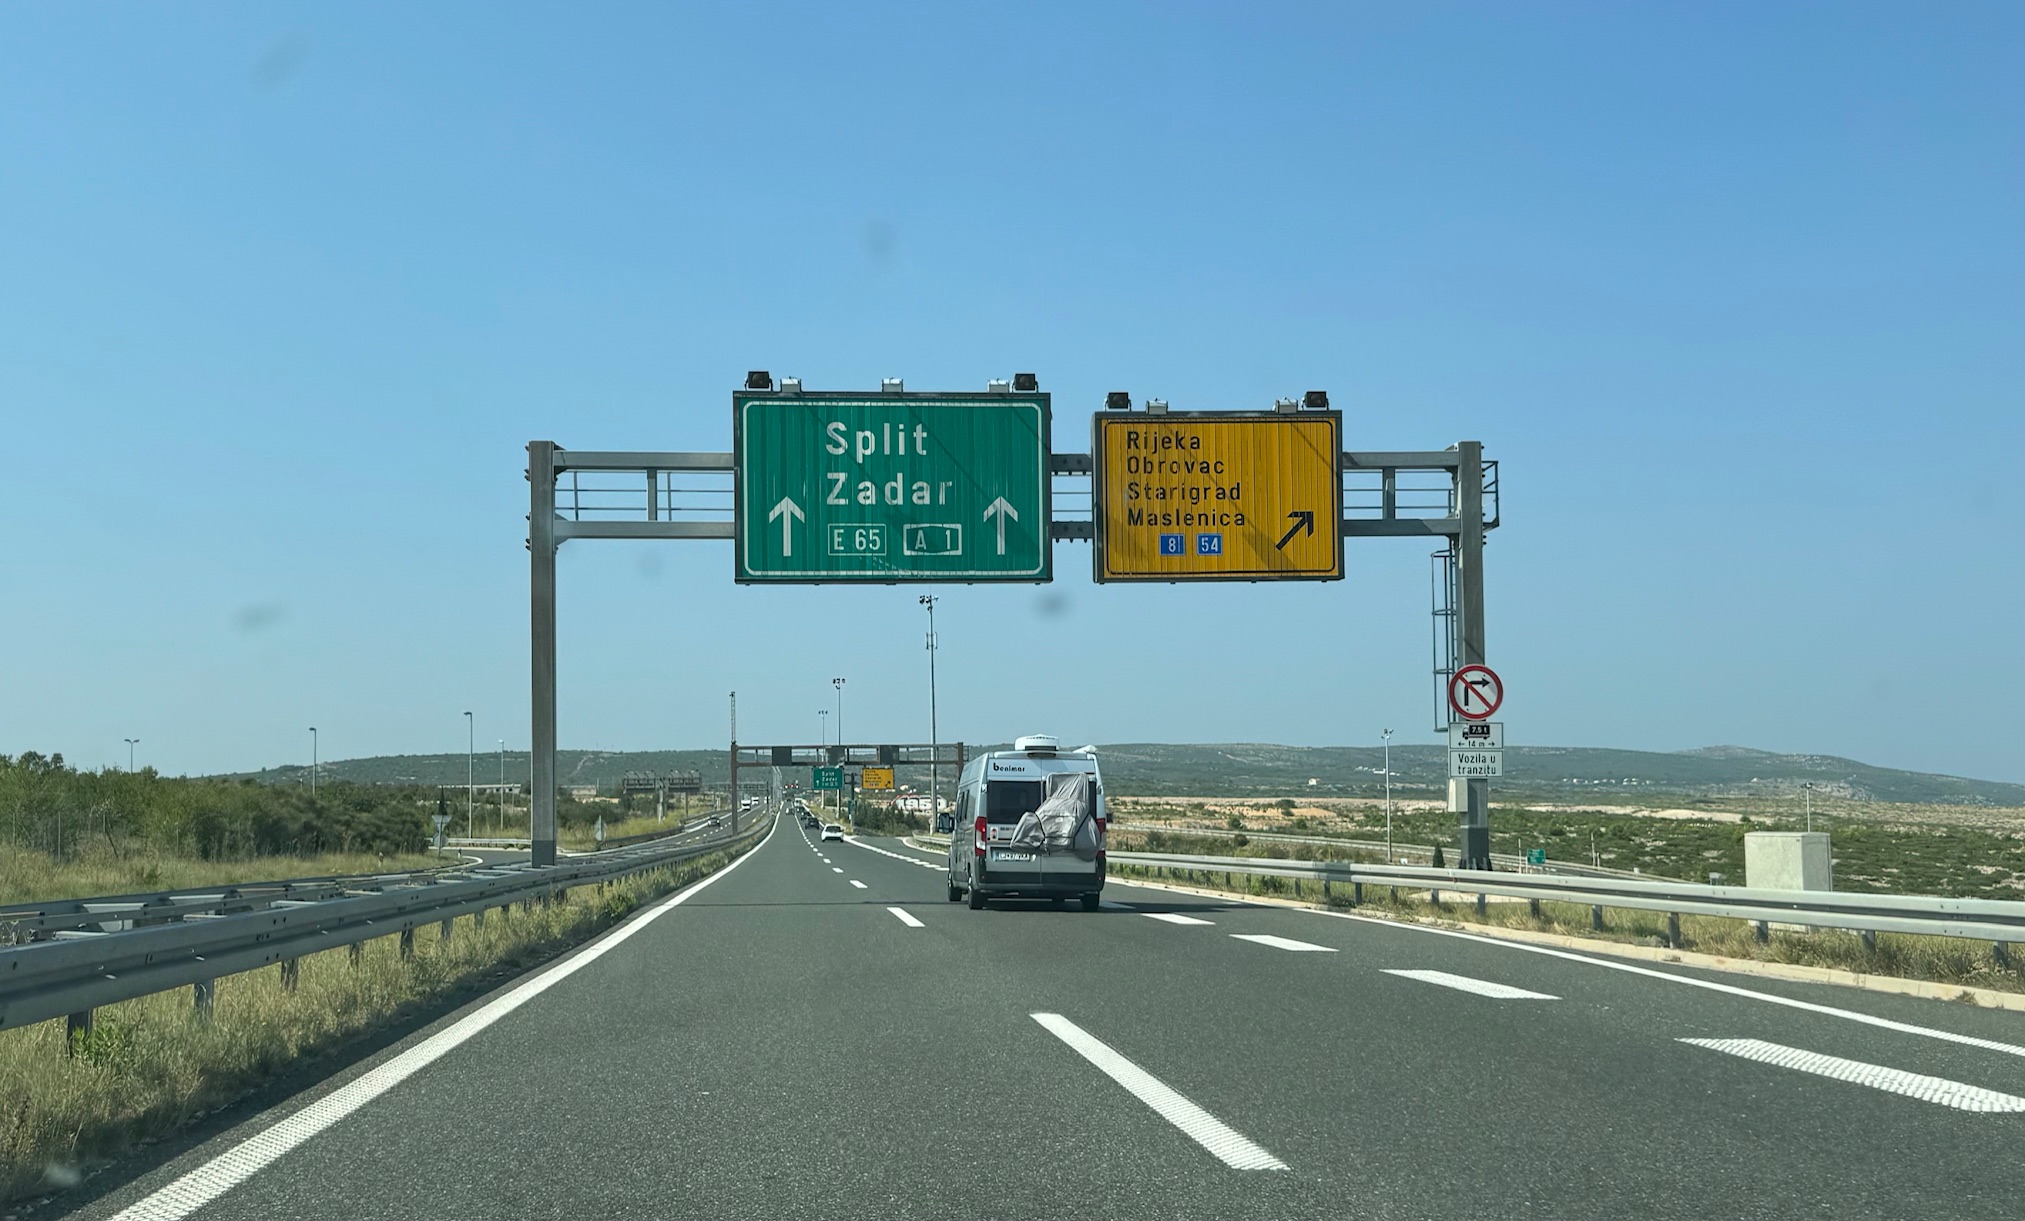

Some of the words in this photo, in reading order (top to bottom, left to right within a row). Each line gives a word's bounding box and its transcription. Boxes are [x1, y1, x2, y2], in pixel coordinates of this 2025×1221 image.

[825, 421, 928, 464] Split
[1127, 430, 1201, 454] Rijeka
[1127, 456, 1225, 474] Obrovac
[826, 472, 953, 506] Zadar
[1127, 481, 1242, 505] Starigrad
[1127, 508, 1245, 527] Maslenica
[833, 529, 843, 550] E
[855, 529, 881, 550] 65
[915, 529, 927, 550] A
[945, 529, 952, 550] 1
[1201, 537, 1219, 552] 54
[993, 762, 1026, 772] benimar
[1458, 753, 1487, 764] Vozila
[1490, 755, 1496, 764] u
[1458, 765, 1496, 775] tranzitu
